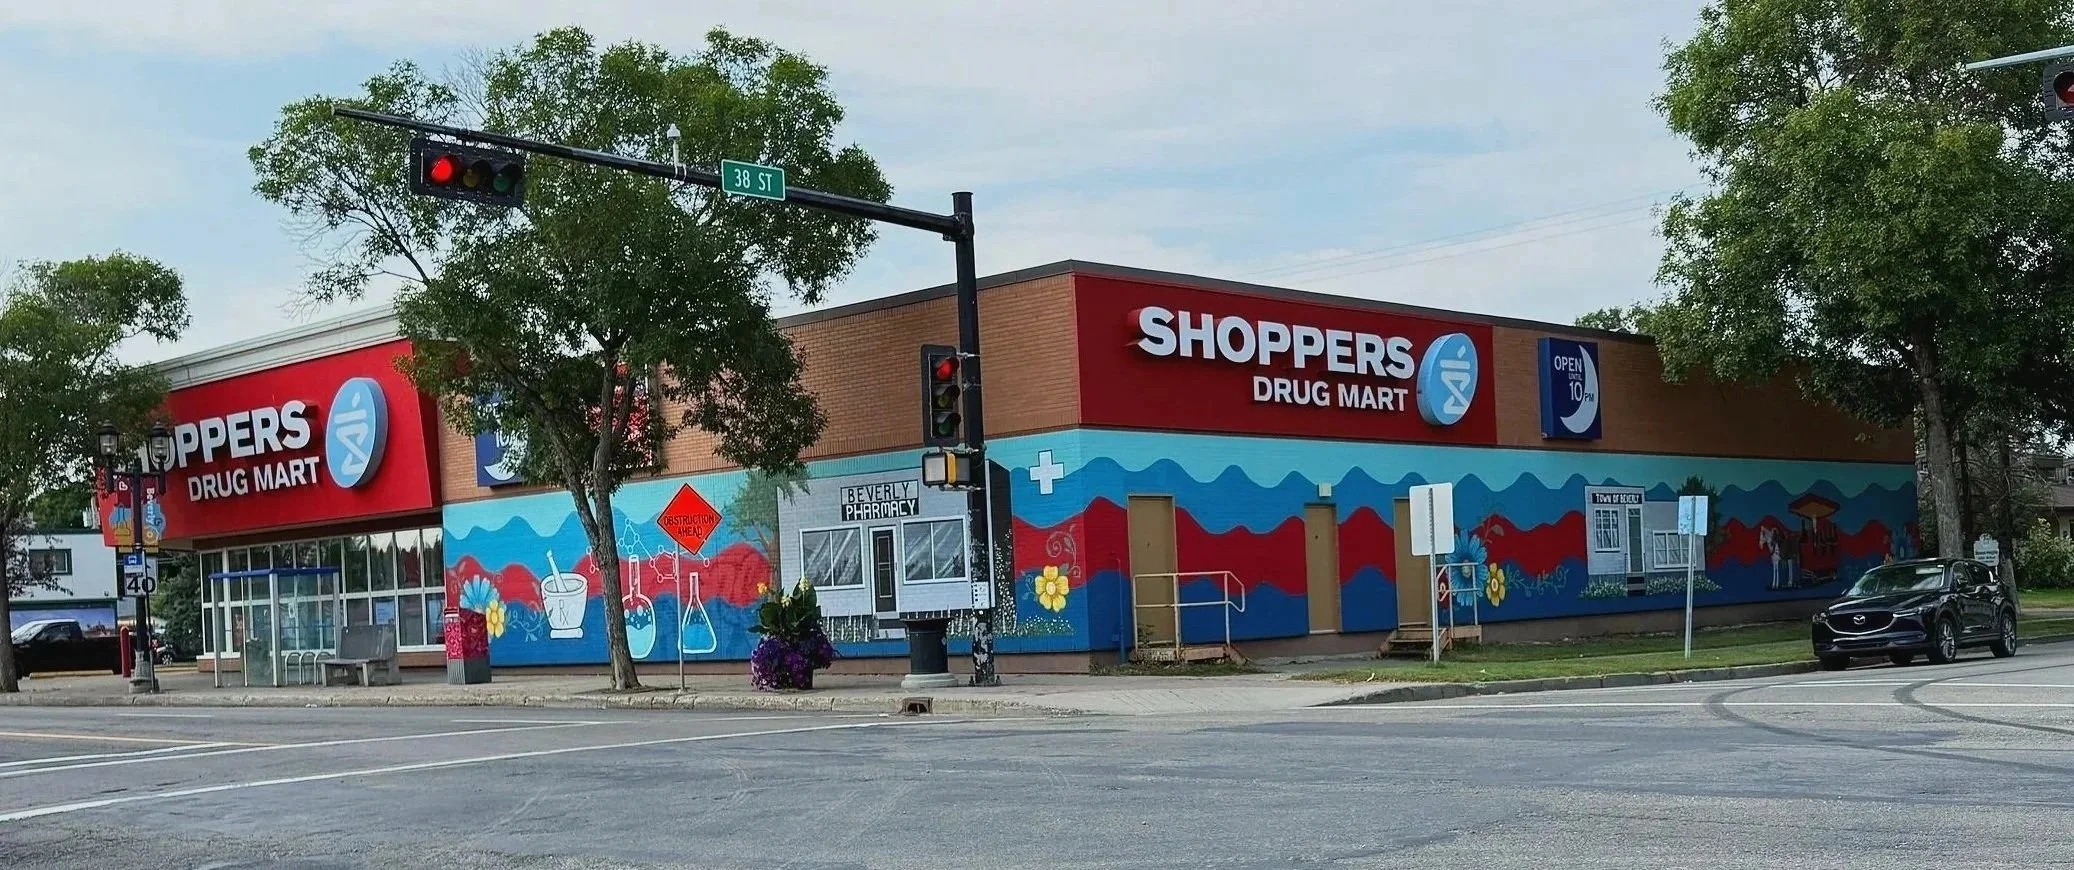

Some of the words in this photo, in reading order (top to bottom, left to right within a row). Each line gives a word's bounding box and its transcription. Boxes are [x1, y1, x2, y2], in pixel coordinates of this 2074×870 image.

[734, 168, 750, 188] 38
[758, 172, 772, 191] ST
[1137, 306, 1415, 380] SHOPPERS
[1554, 355, 1582, 372] OPEN
[1568, 372, 1582, 381] UNTIL
[1253, 375, 1330, 407] DRUG
[1338, 383, 1409, 412] MART
[1569, 381, 1583, 402] 10
[1584, 392, 1595, 402] PM
[188, 468, 248, 501] DRUG
[254, 456, 319, 492] MART
[848, 482, 909, 503] BEVERLY
[146, 487, 155, 527] Beverly
[846, 500, 915, 520] PHARMACY
[664, 514, 715, 526] OBSTRUCTION
[678, 525, 703, 539] AHEAD
[127, 576, 156, 593] 40
